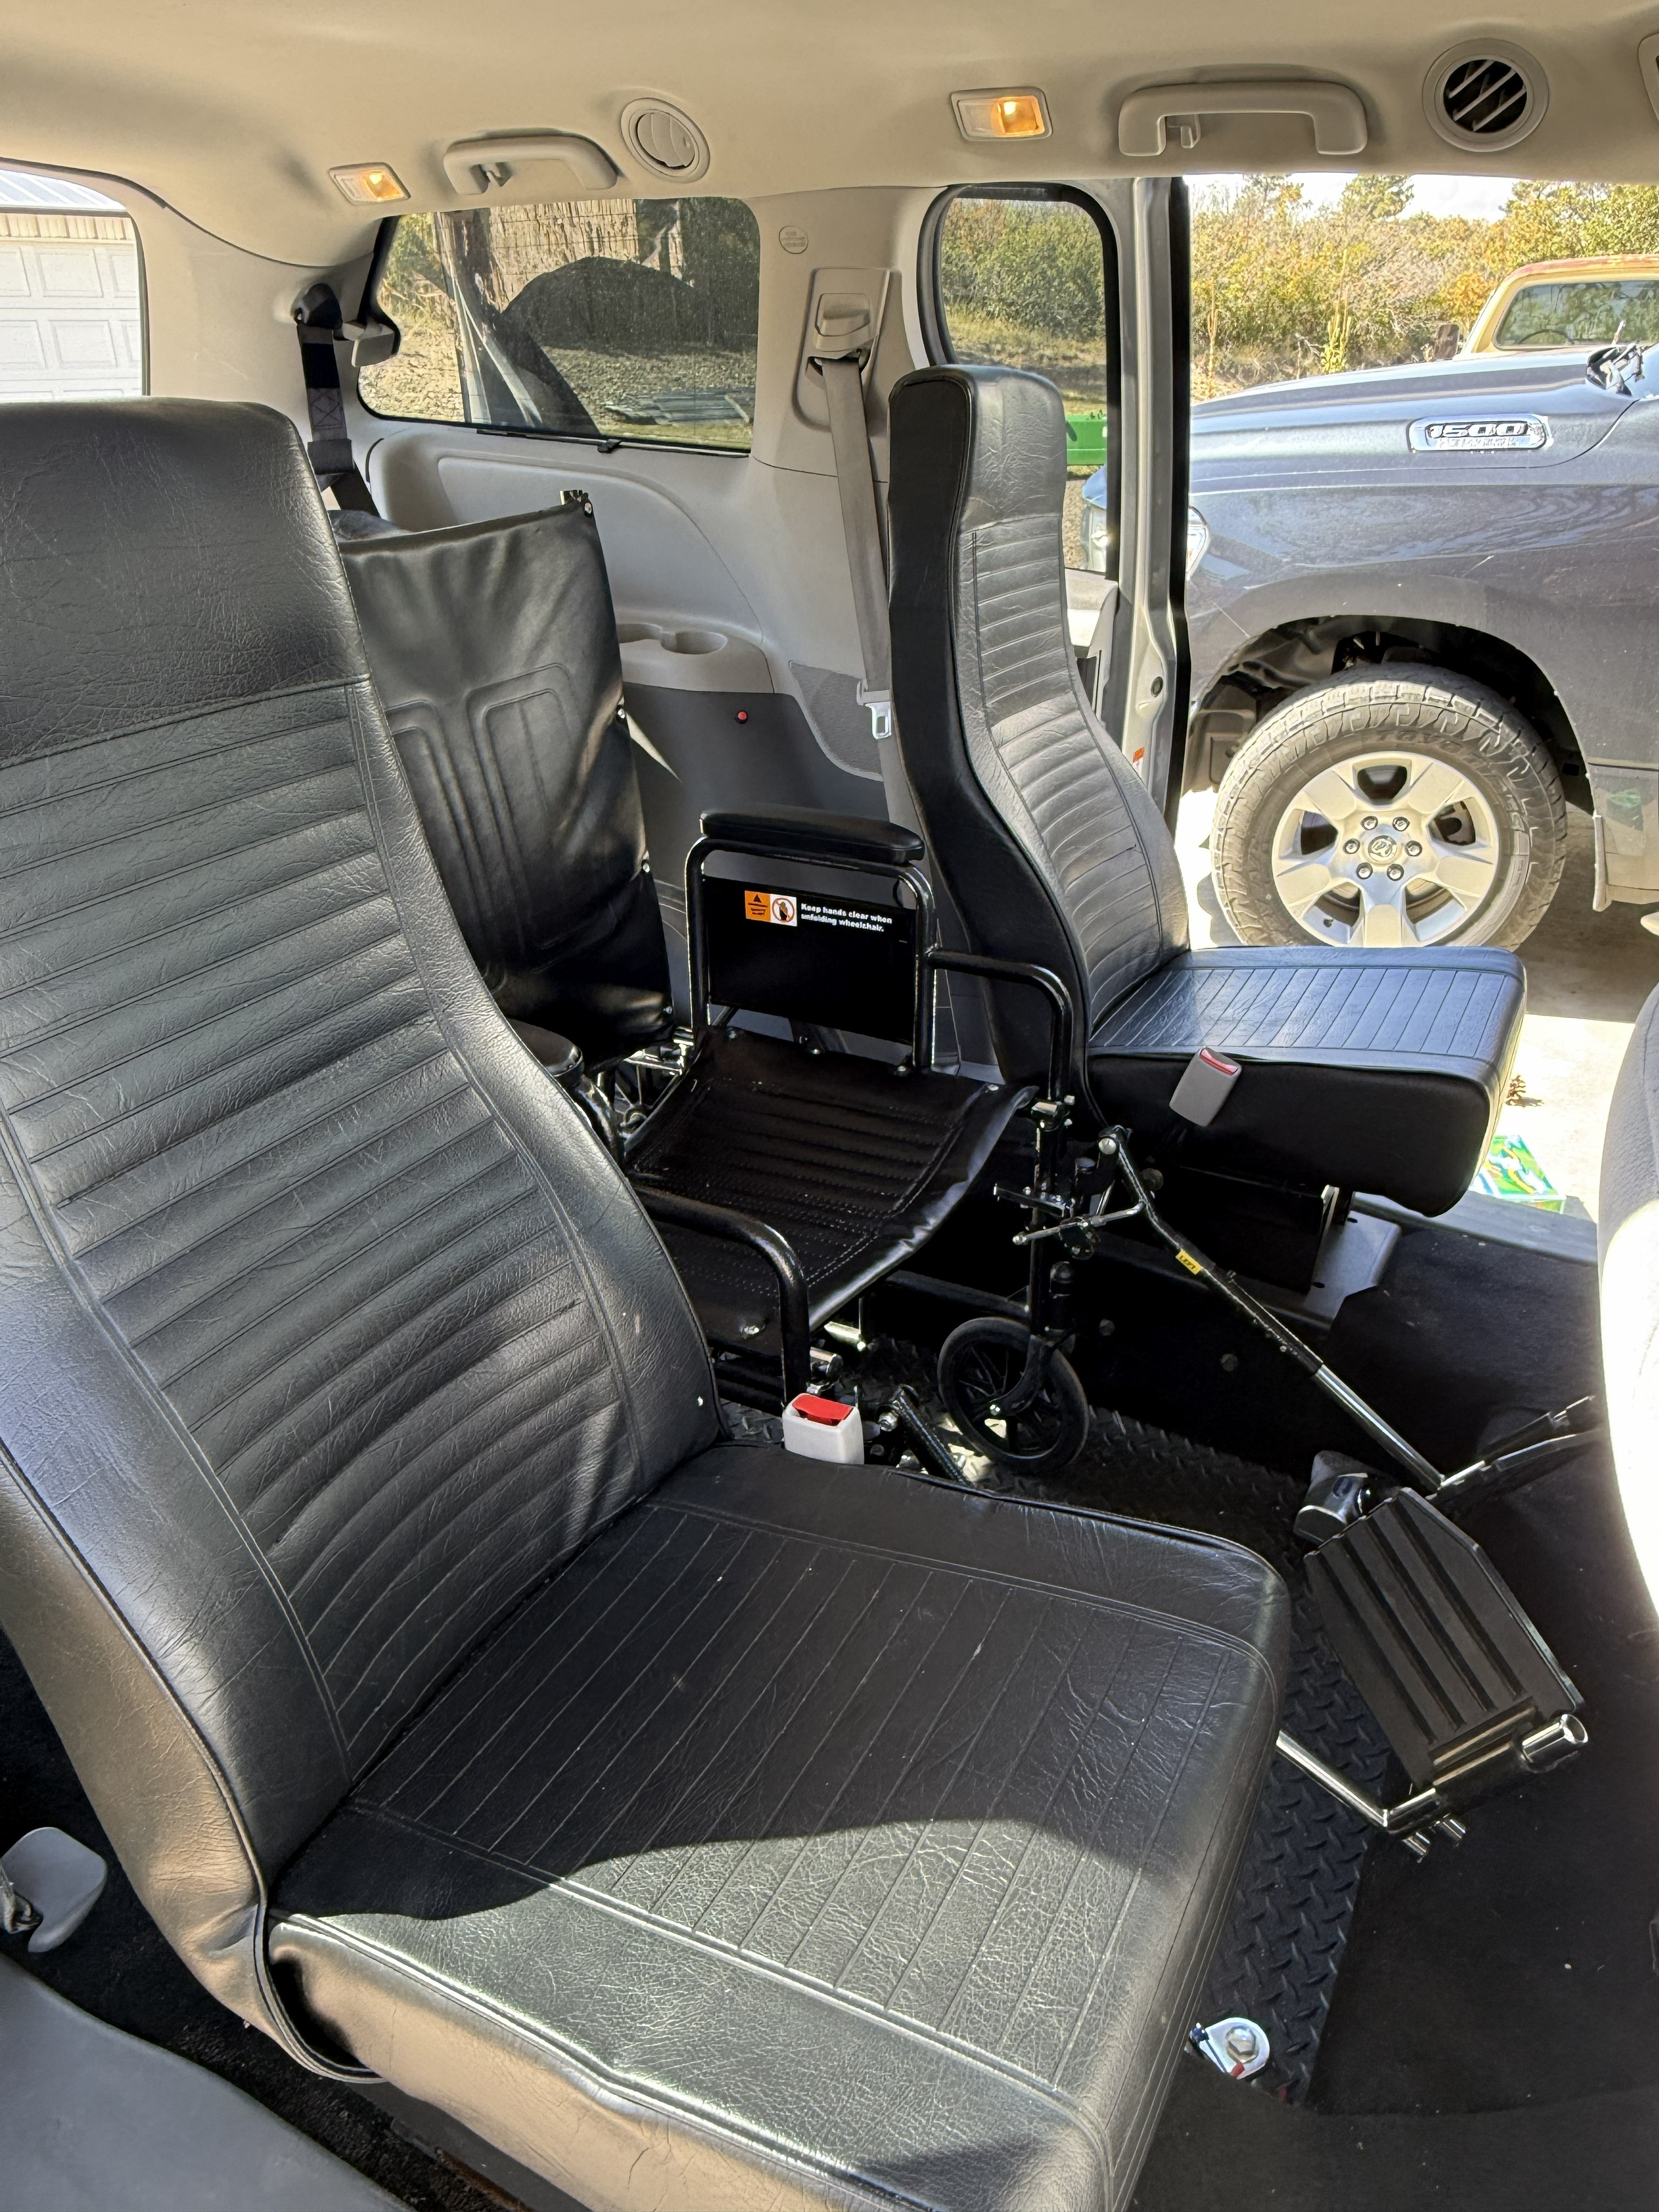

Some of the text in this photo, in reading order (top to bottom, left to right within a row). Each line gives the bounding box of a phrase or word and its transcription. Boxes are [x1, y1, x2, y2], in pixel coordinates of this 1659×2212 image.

[1427, 421, 1528, 438] 1500
[801, 903, 892, 924] Keep hands clear when
[801, 913, 884, 932] unfolding wheelchair.
